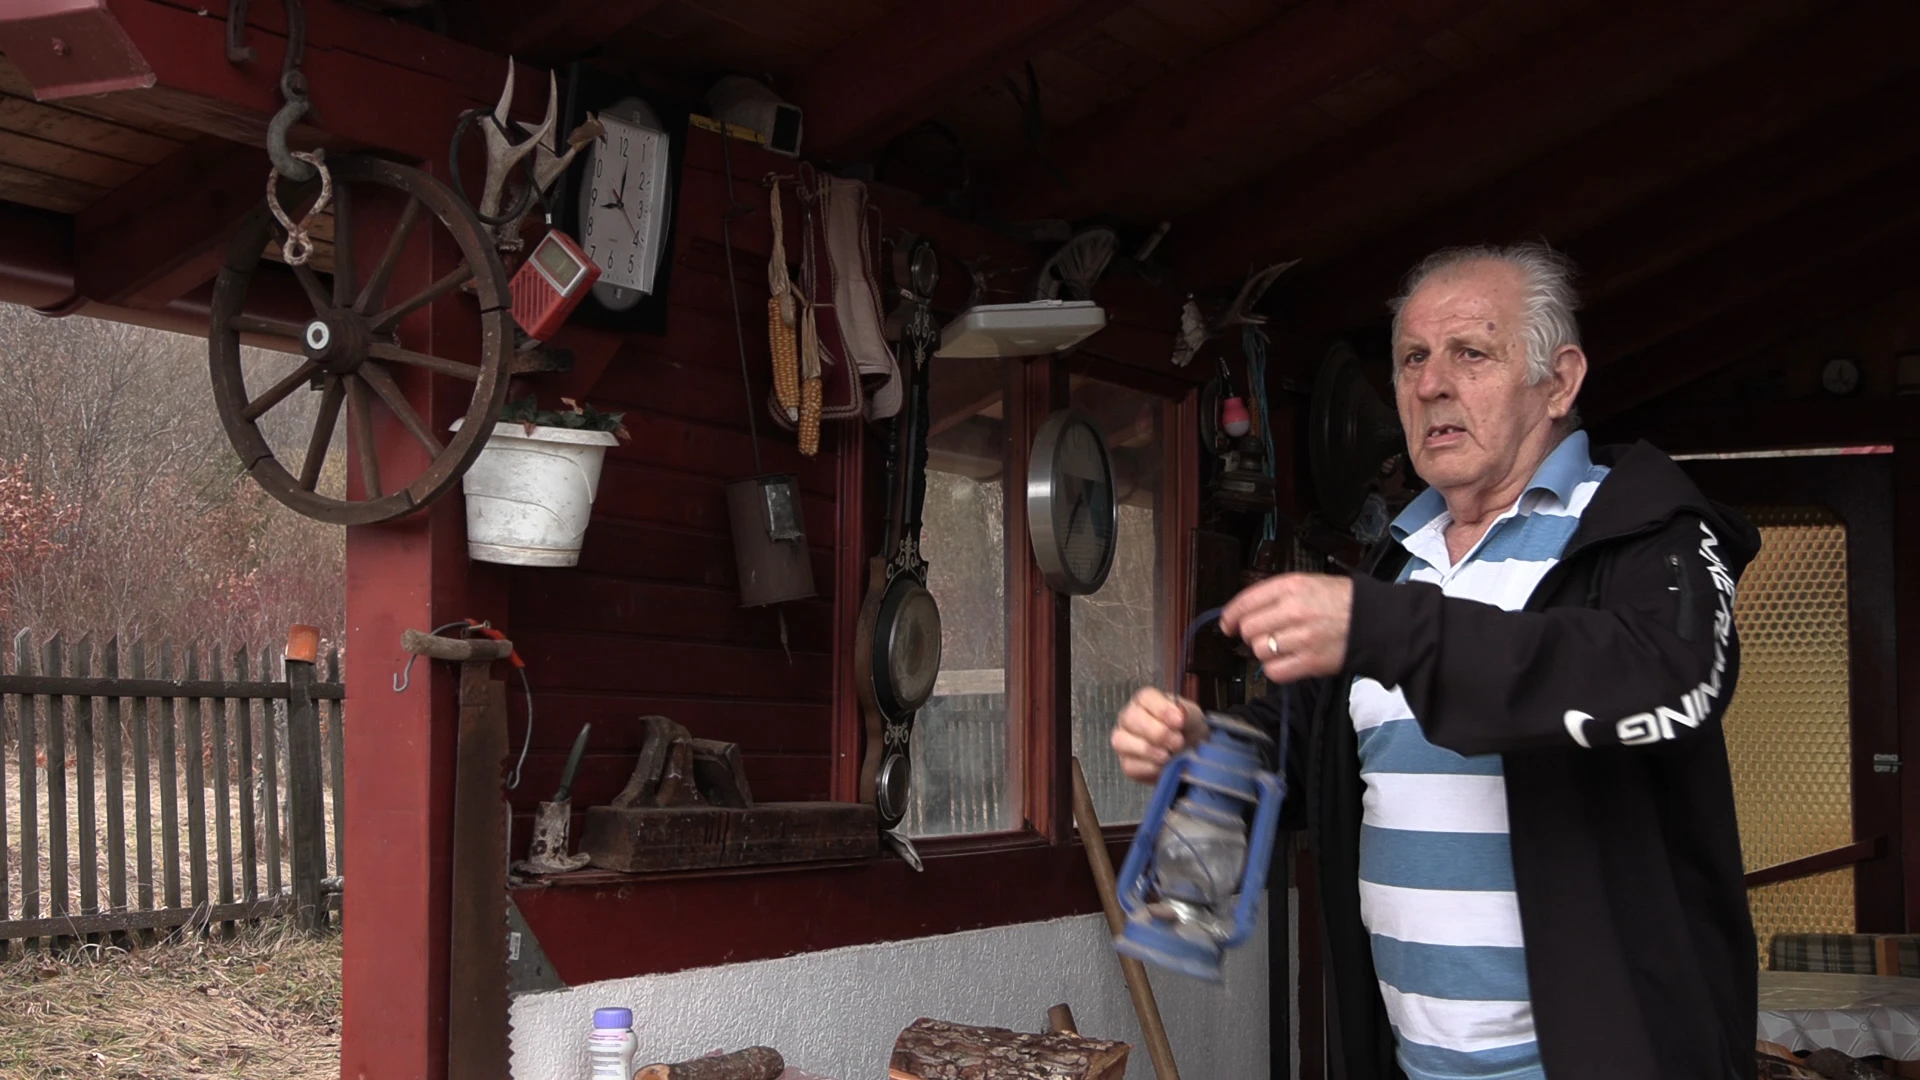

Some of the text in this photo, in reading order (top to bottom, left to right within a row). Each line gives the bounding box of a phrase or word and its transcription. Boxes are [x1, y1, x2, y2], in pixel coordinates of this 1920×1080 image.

[619, 136, 629, 158] 12
[639, 171, 645, 191] 2
[592, 187, 598, 207] 9
[638, 200, 643, 219] 3
[587, 216, 593, 236] 8
[633, 229, 640, 248] 4
[591, 245, 596, 259] 7
[608, 250, 613, 269] 6
[628, 254, 634, 274] 5
